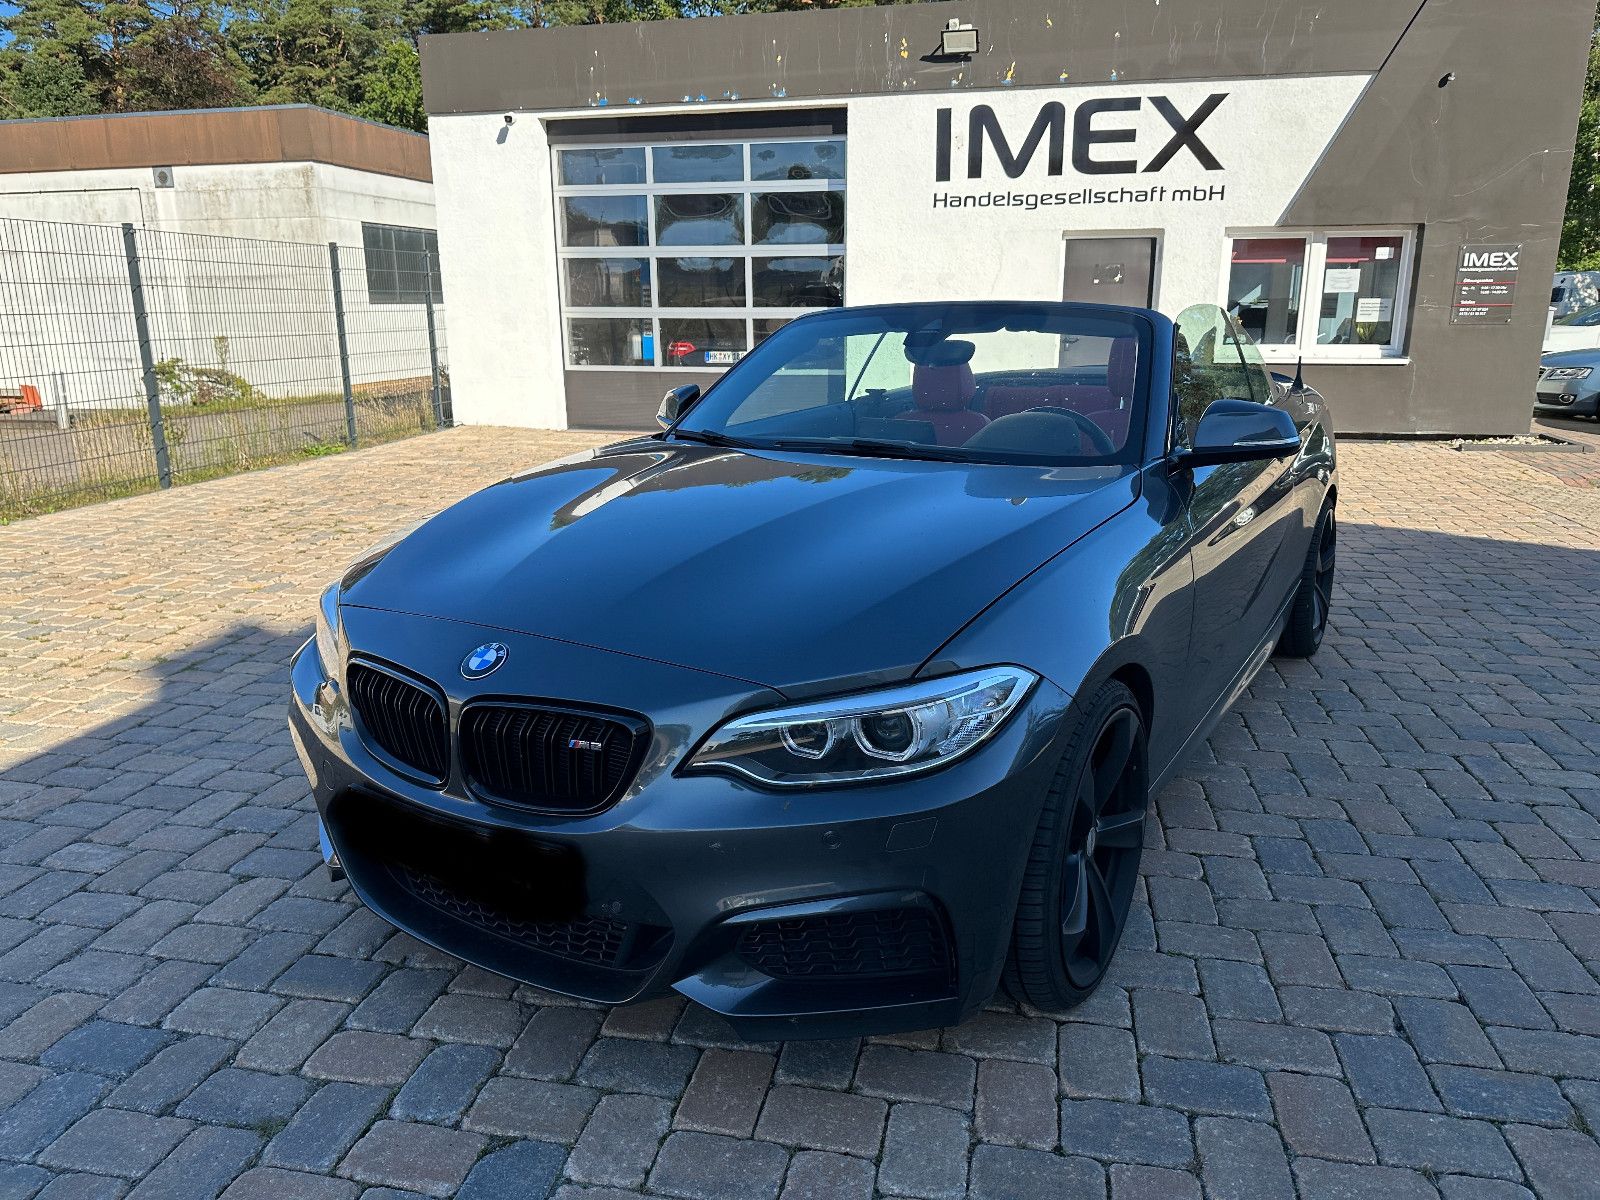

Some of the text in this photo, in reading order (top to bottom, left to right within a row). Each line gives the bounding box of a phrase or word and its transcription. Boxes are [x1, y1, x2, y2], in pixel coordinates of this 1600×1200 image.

[935, 92, 1230, 182] IMEX
[932, 185, 1226, 210] Handelsgesellschaft mbH
[1463, 251, 1519, 267] IMEX
